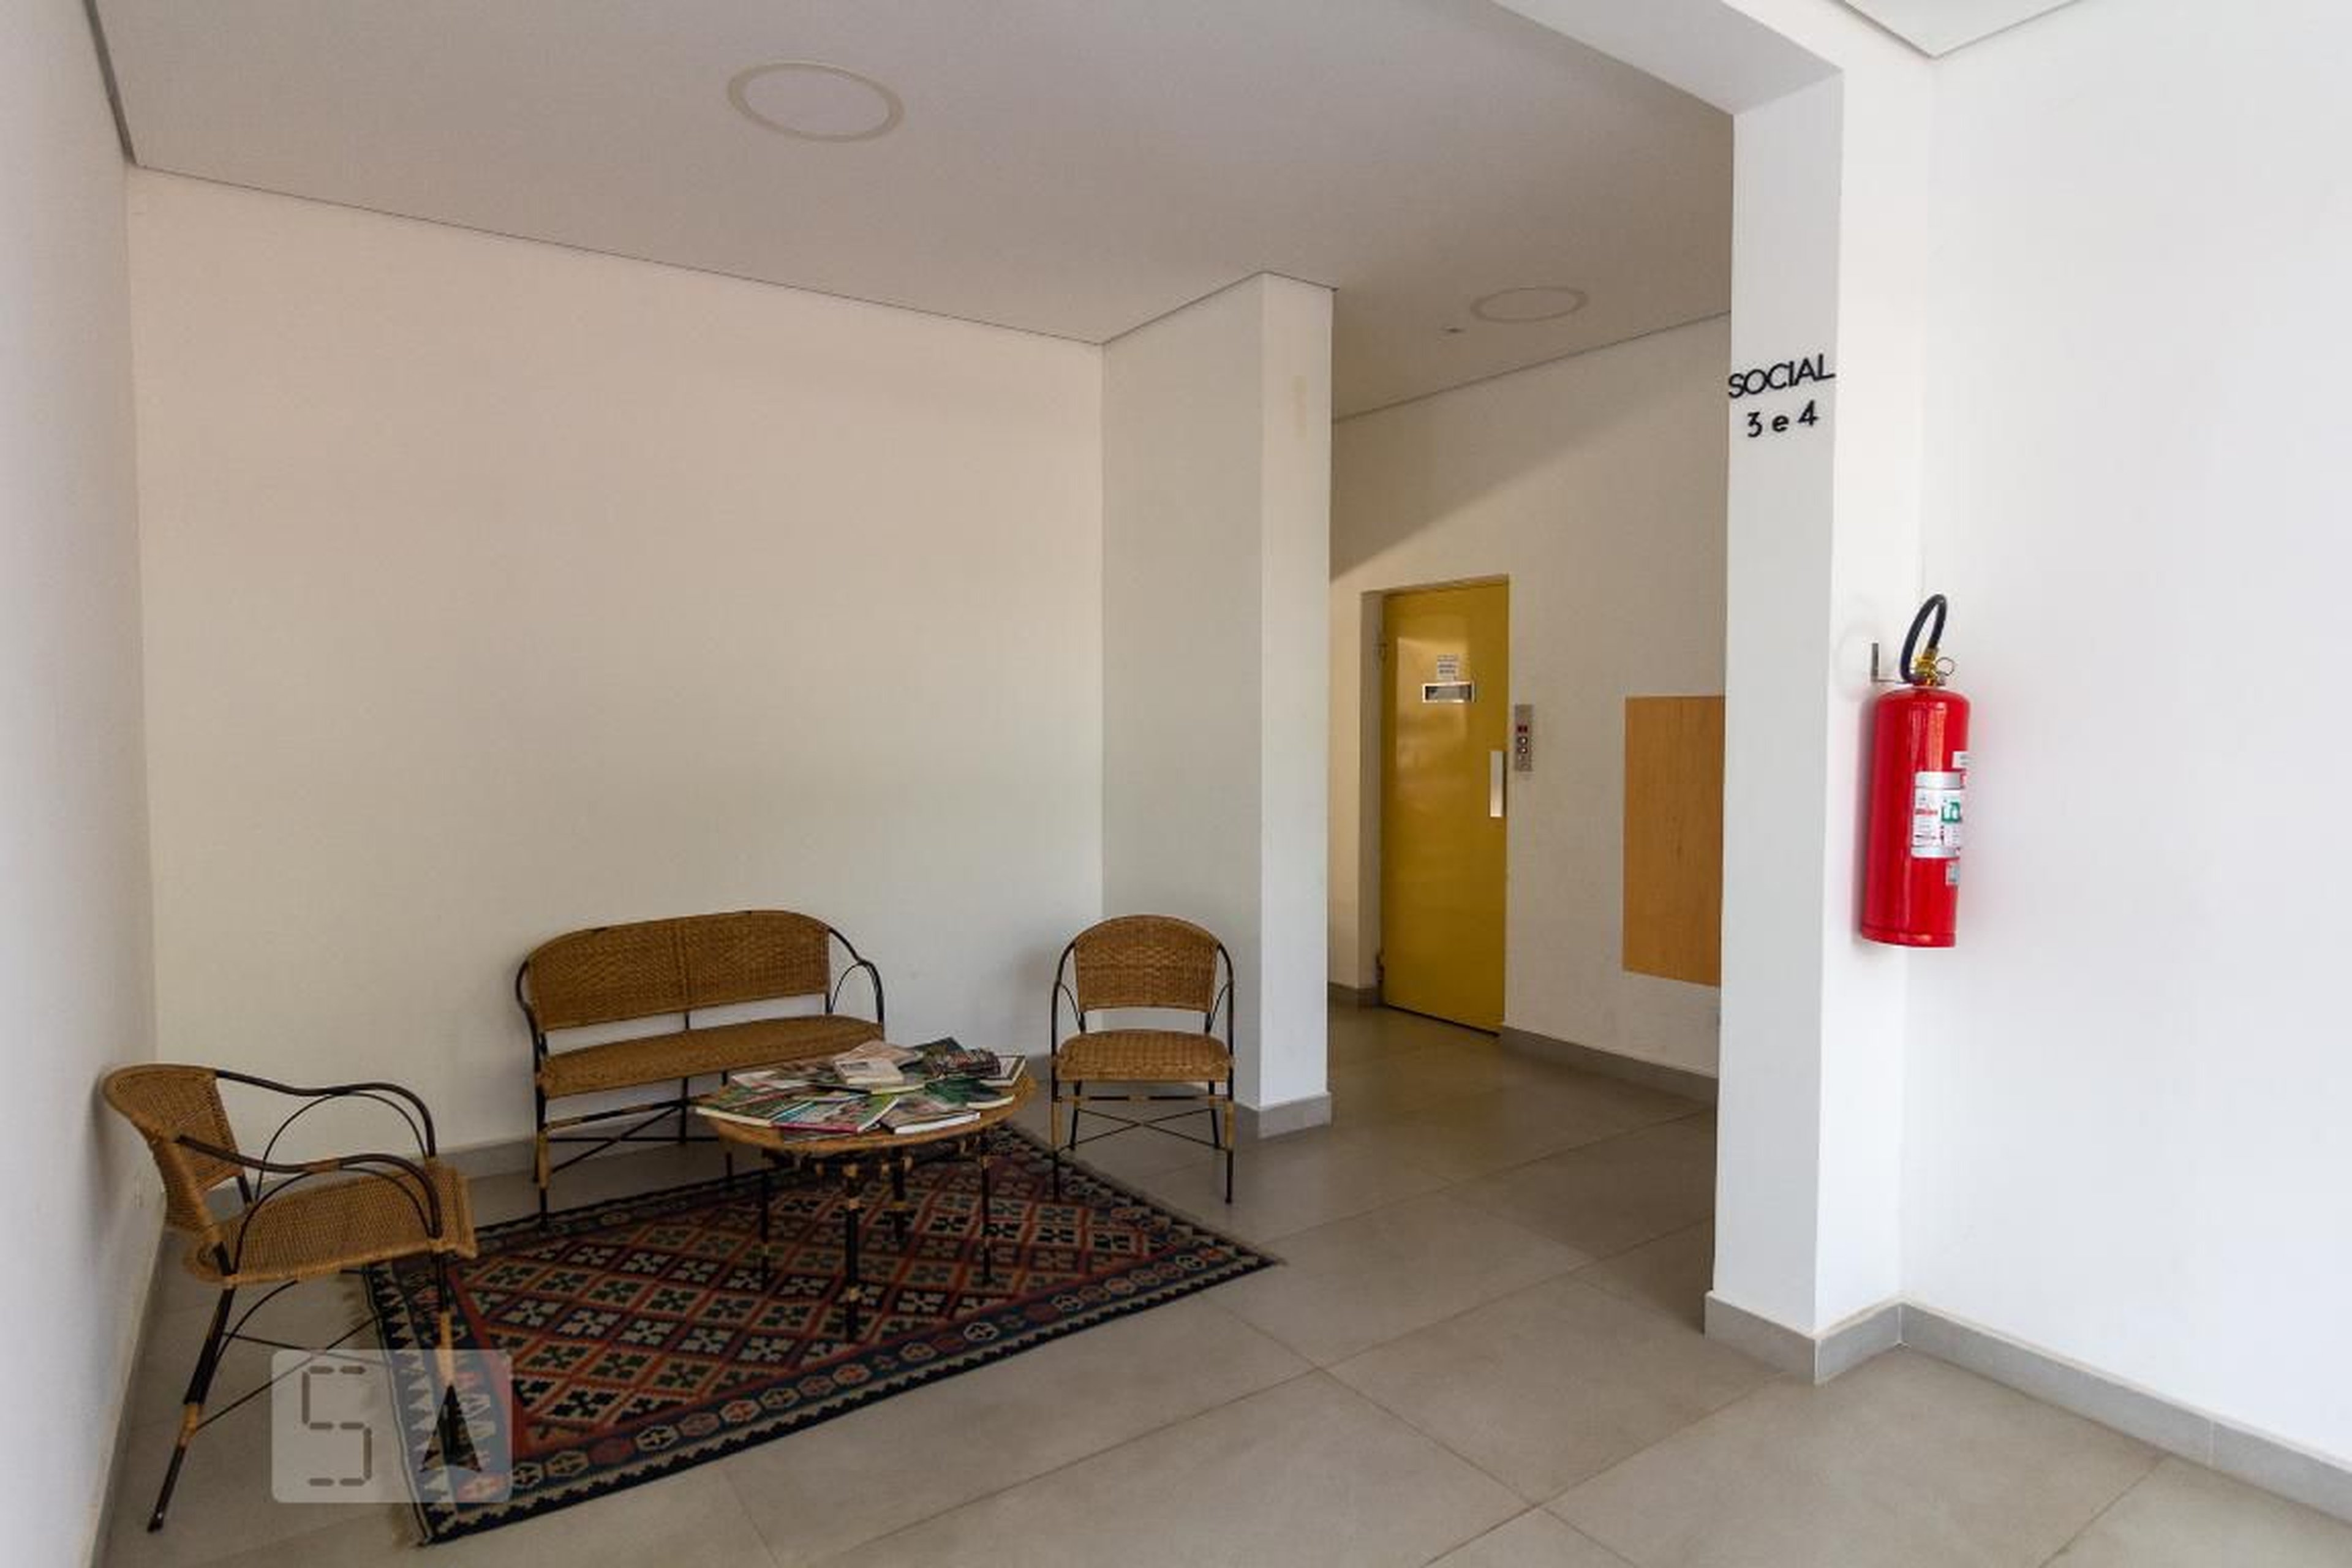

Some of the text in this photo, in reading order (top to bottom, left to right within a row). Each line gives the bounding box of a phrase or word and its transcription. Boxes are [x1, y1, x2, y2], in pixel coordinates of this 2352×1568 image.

[1728, 353, 1836, 398] SOCIAL
[1747, 399, 1819, 438] 3 e 4
